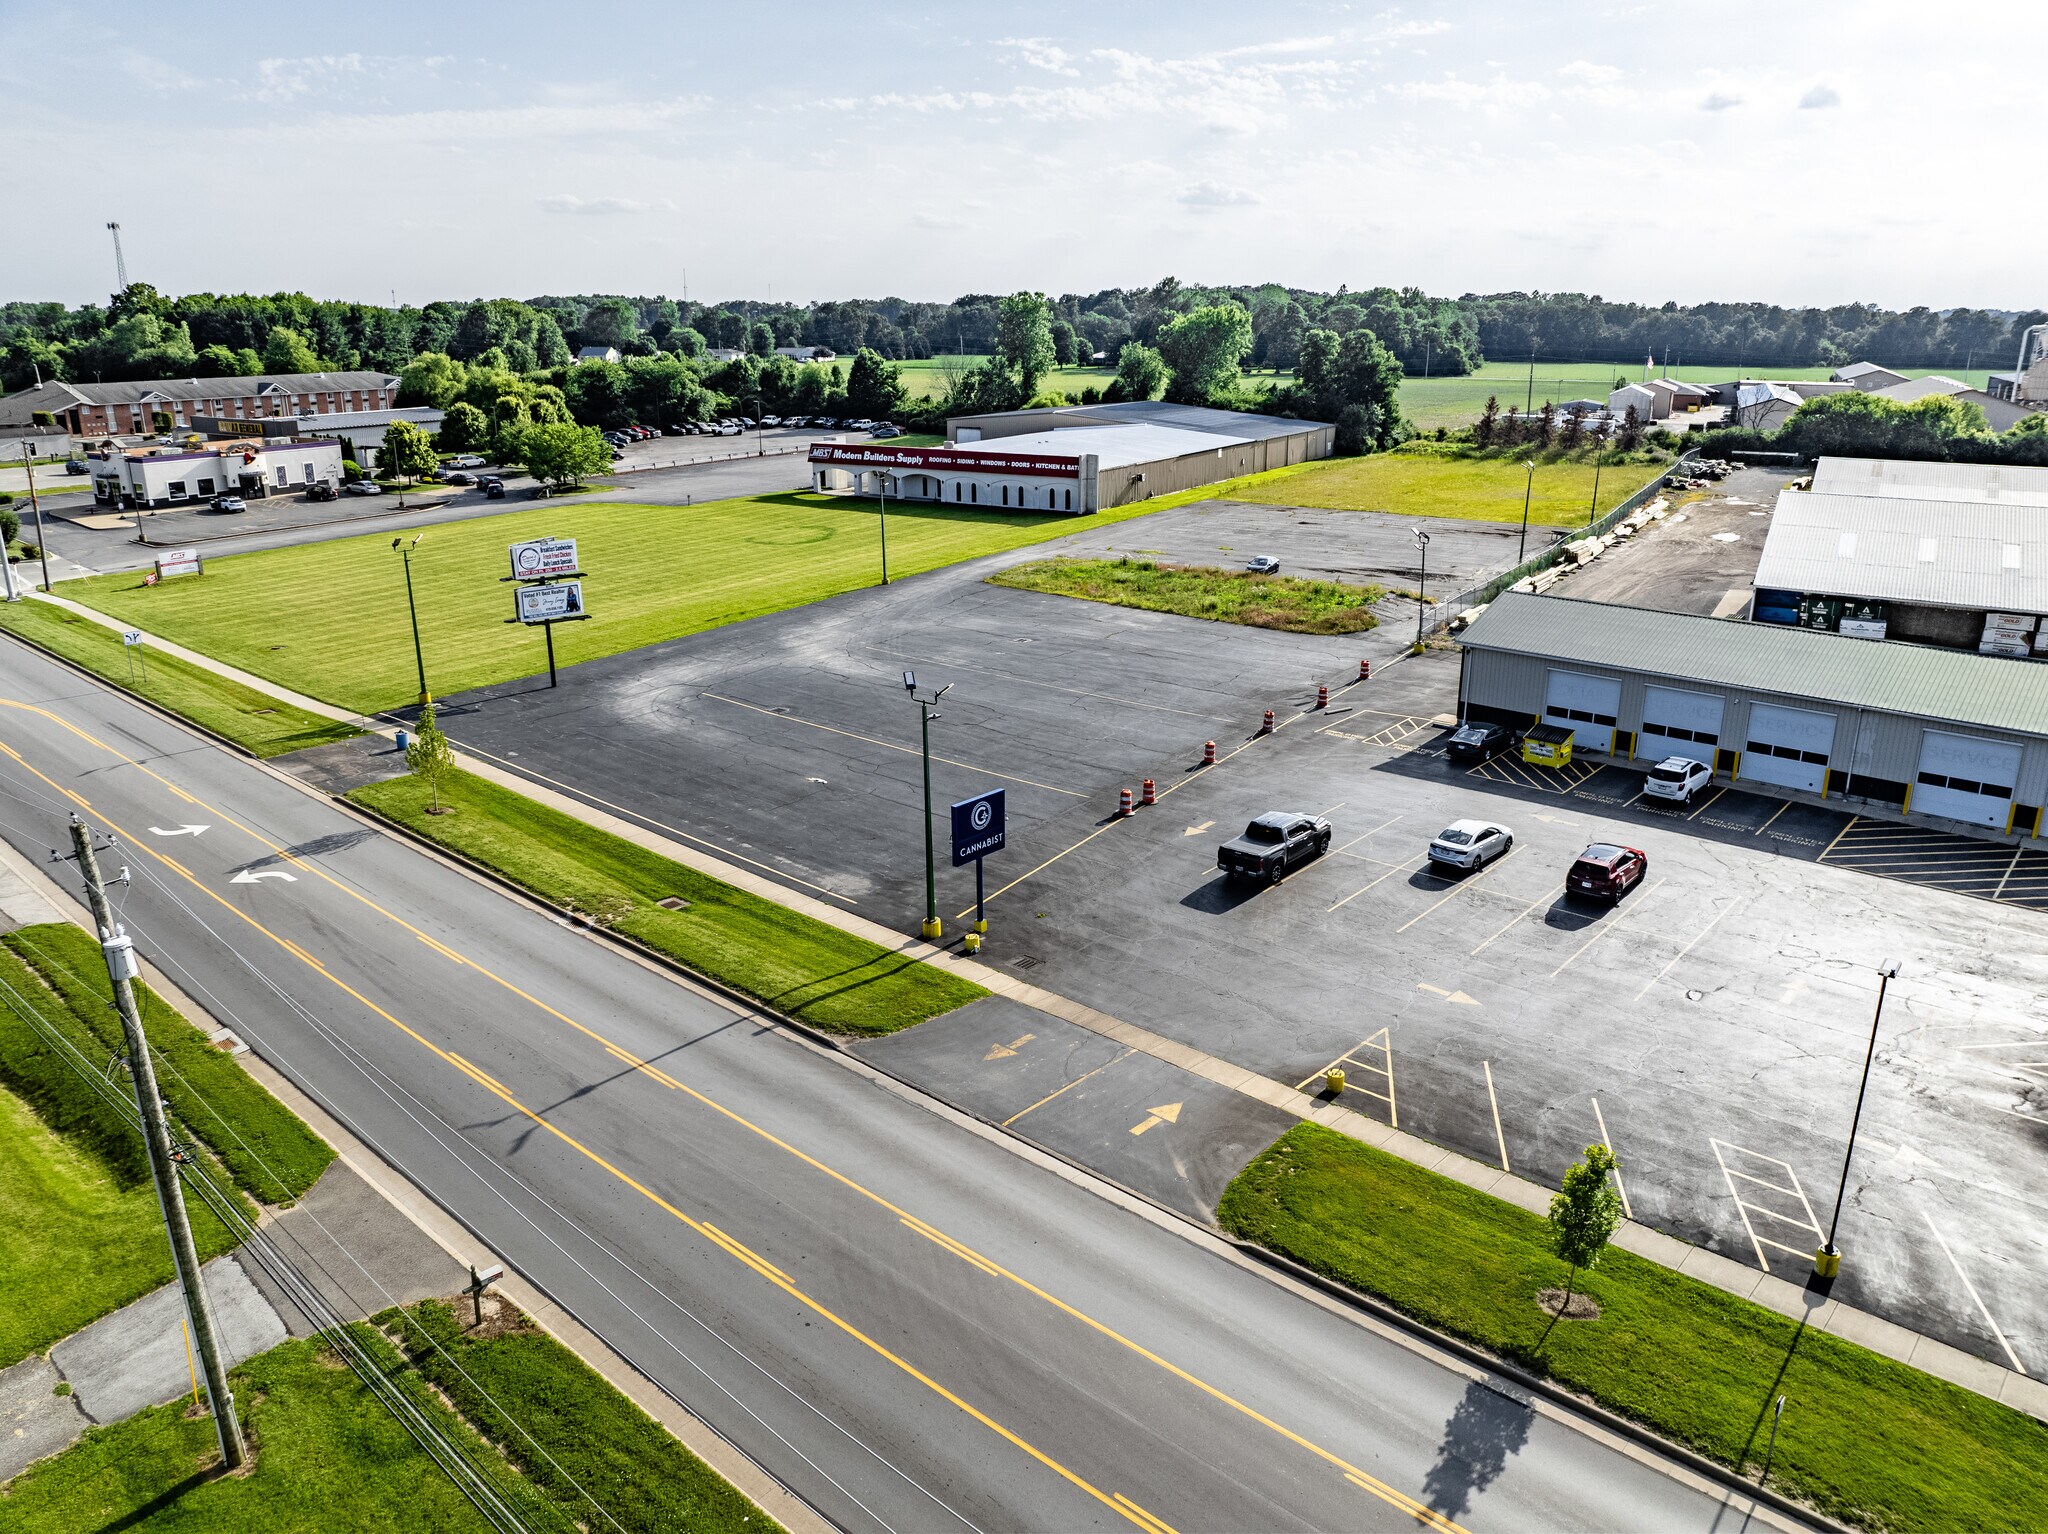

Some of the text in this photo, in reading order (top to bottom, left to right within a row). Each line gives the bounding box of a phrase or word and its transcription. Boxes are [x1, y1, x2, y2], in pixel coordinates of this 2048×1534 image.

[239, 422, 263, 434] GENERAL
[810, 447, 923, 465] MBS Modern Builders Supply
[928, 456, 952, 464] ROOFING
[980, 459, 1006, 467] WINDOWS
[1035, 462, 1060, 470] KITCHEN
[1573, 789, 1625, 803] EMPLOYEE
[1574, 793, 1614, 805] PARKING
[1636, 806, 1678, 818] PARKING
[1699, 815, 1756, 831] EMPLOYEE
[1702, 820, 1745, 832] PARKING
[960, 833, 1003, 857] CANNABIST
[1767, 830, 1826, 846] EMPLOYEE
[1771, 834, 1816, 847] PARKING
